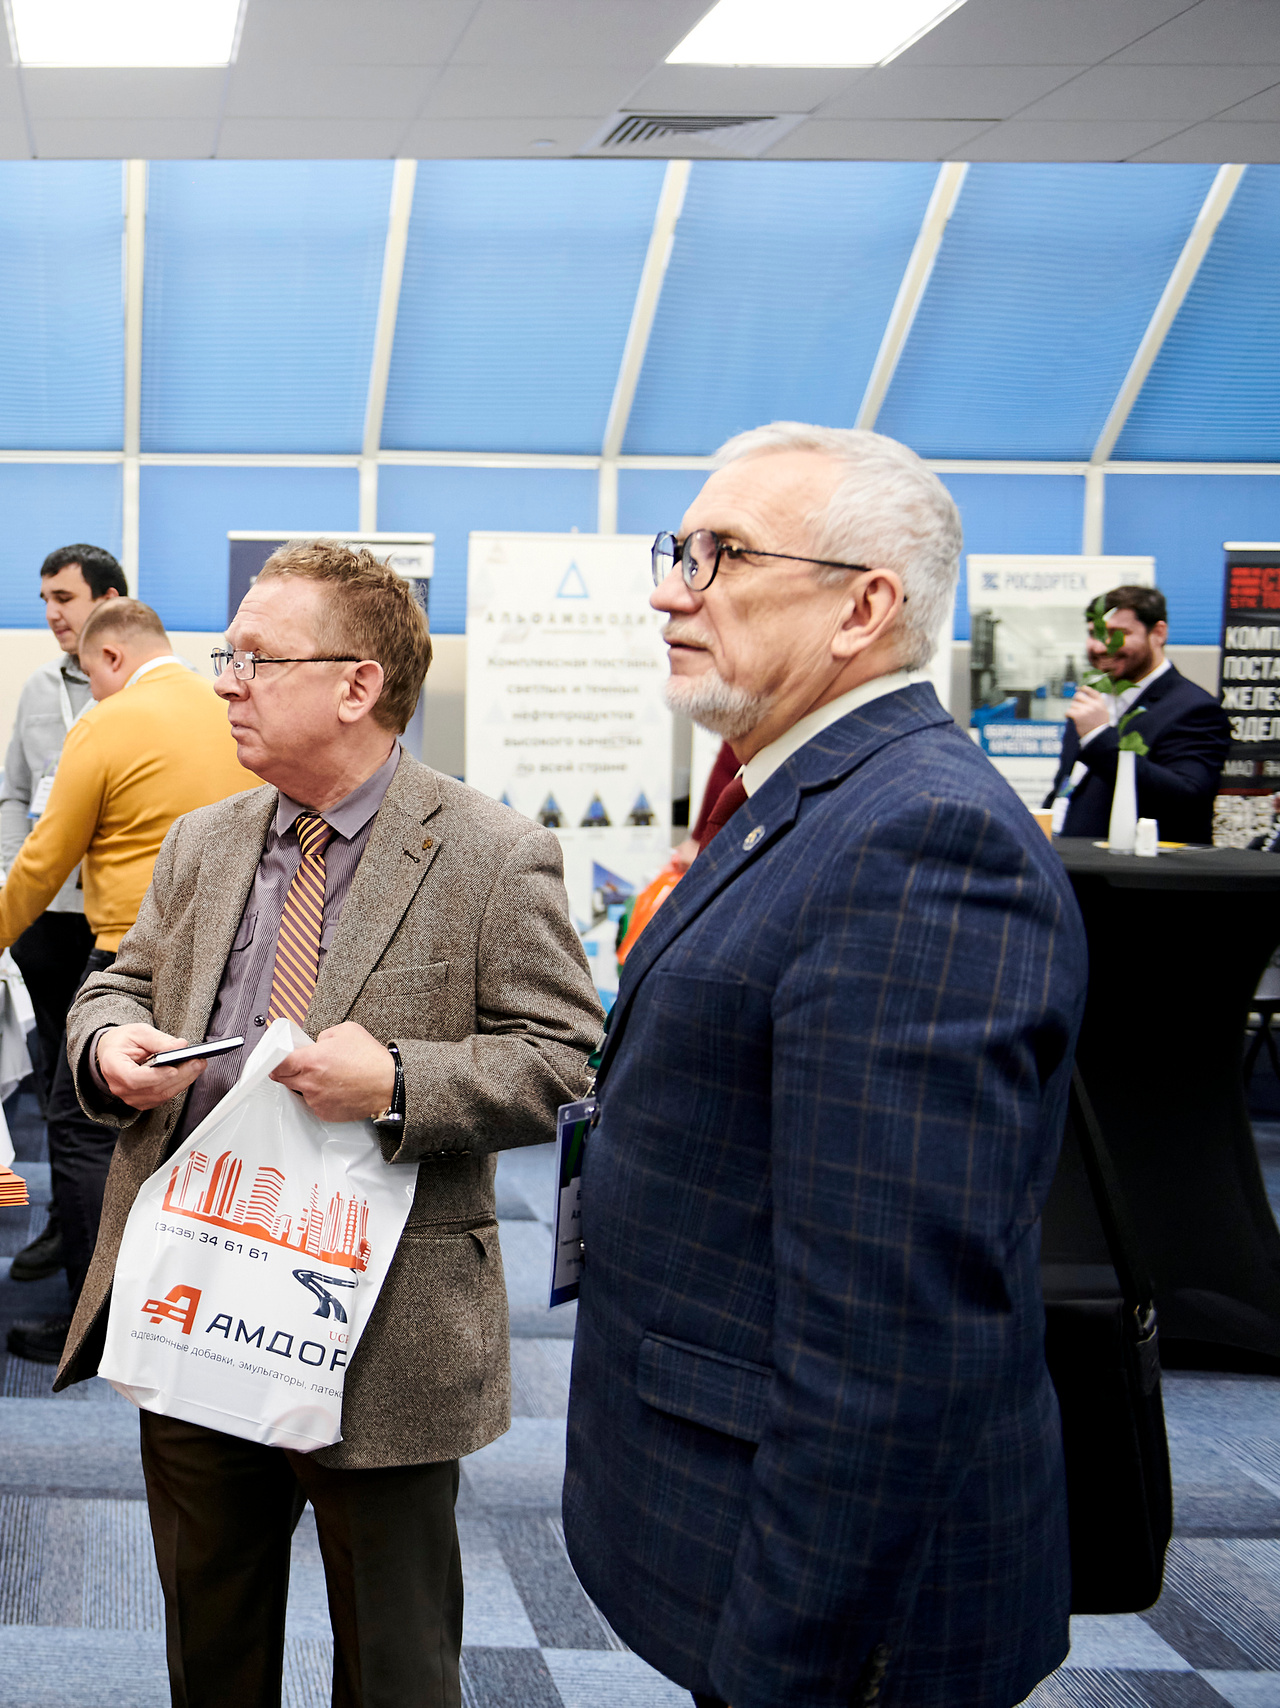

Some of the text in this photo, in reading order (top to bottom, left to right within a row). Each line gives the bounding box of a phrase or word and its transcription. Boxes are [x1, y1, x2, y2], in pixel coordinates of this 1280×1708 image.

[154, 1221, 268, 1262] (3435) 34 61 61
[130, 1329, 189, 1352] адгезионные
[191, 1345, 235, 1367] добавки,
[238, 1360, 307, 1389] эмульгаторы,
